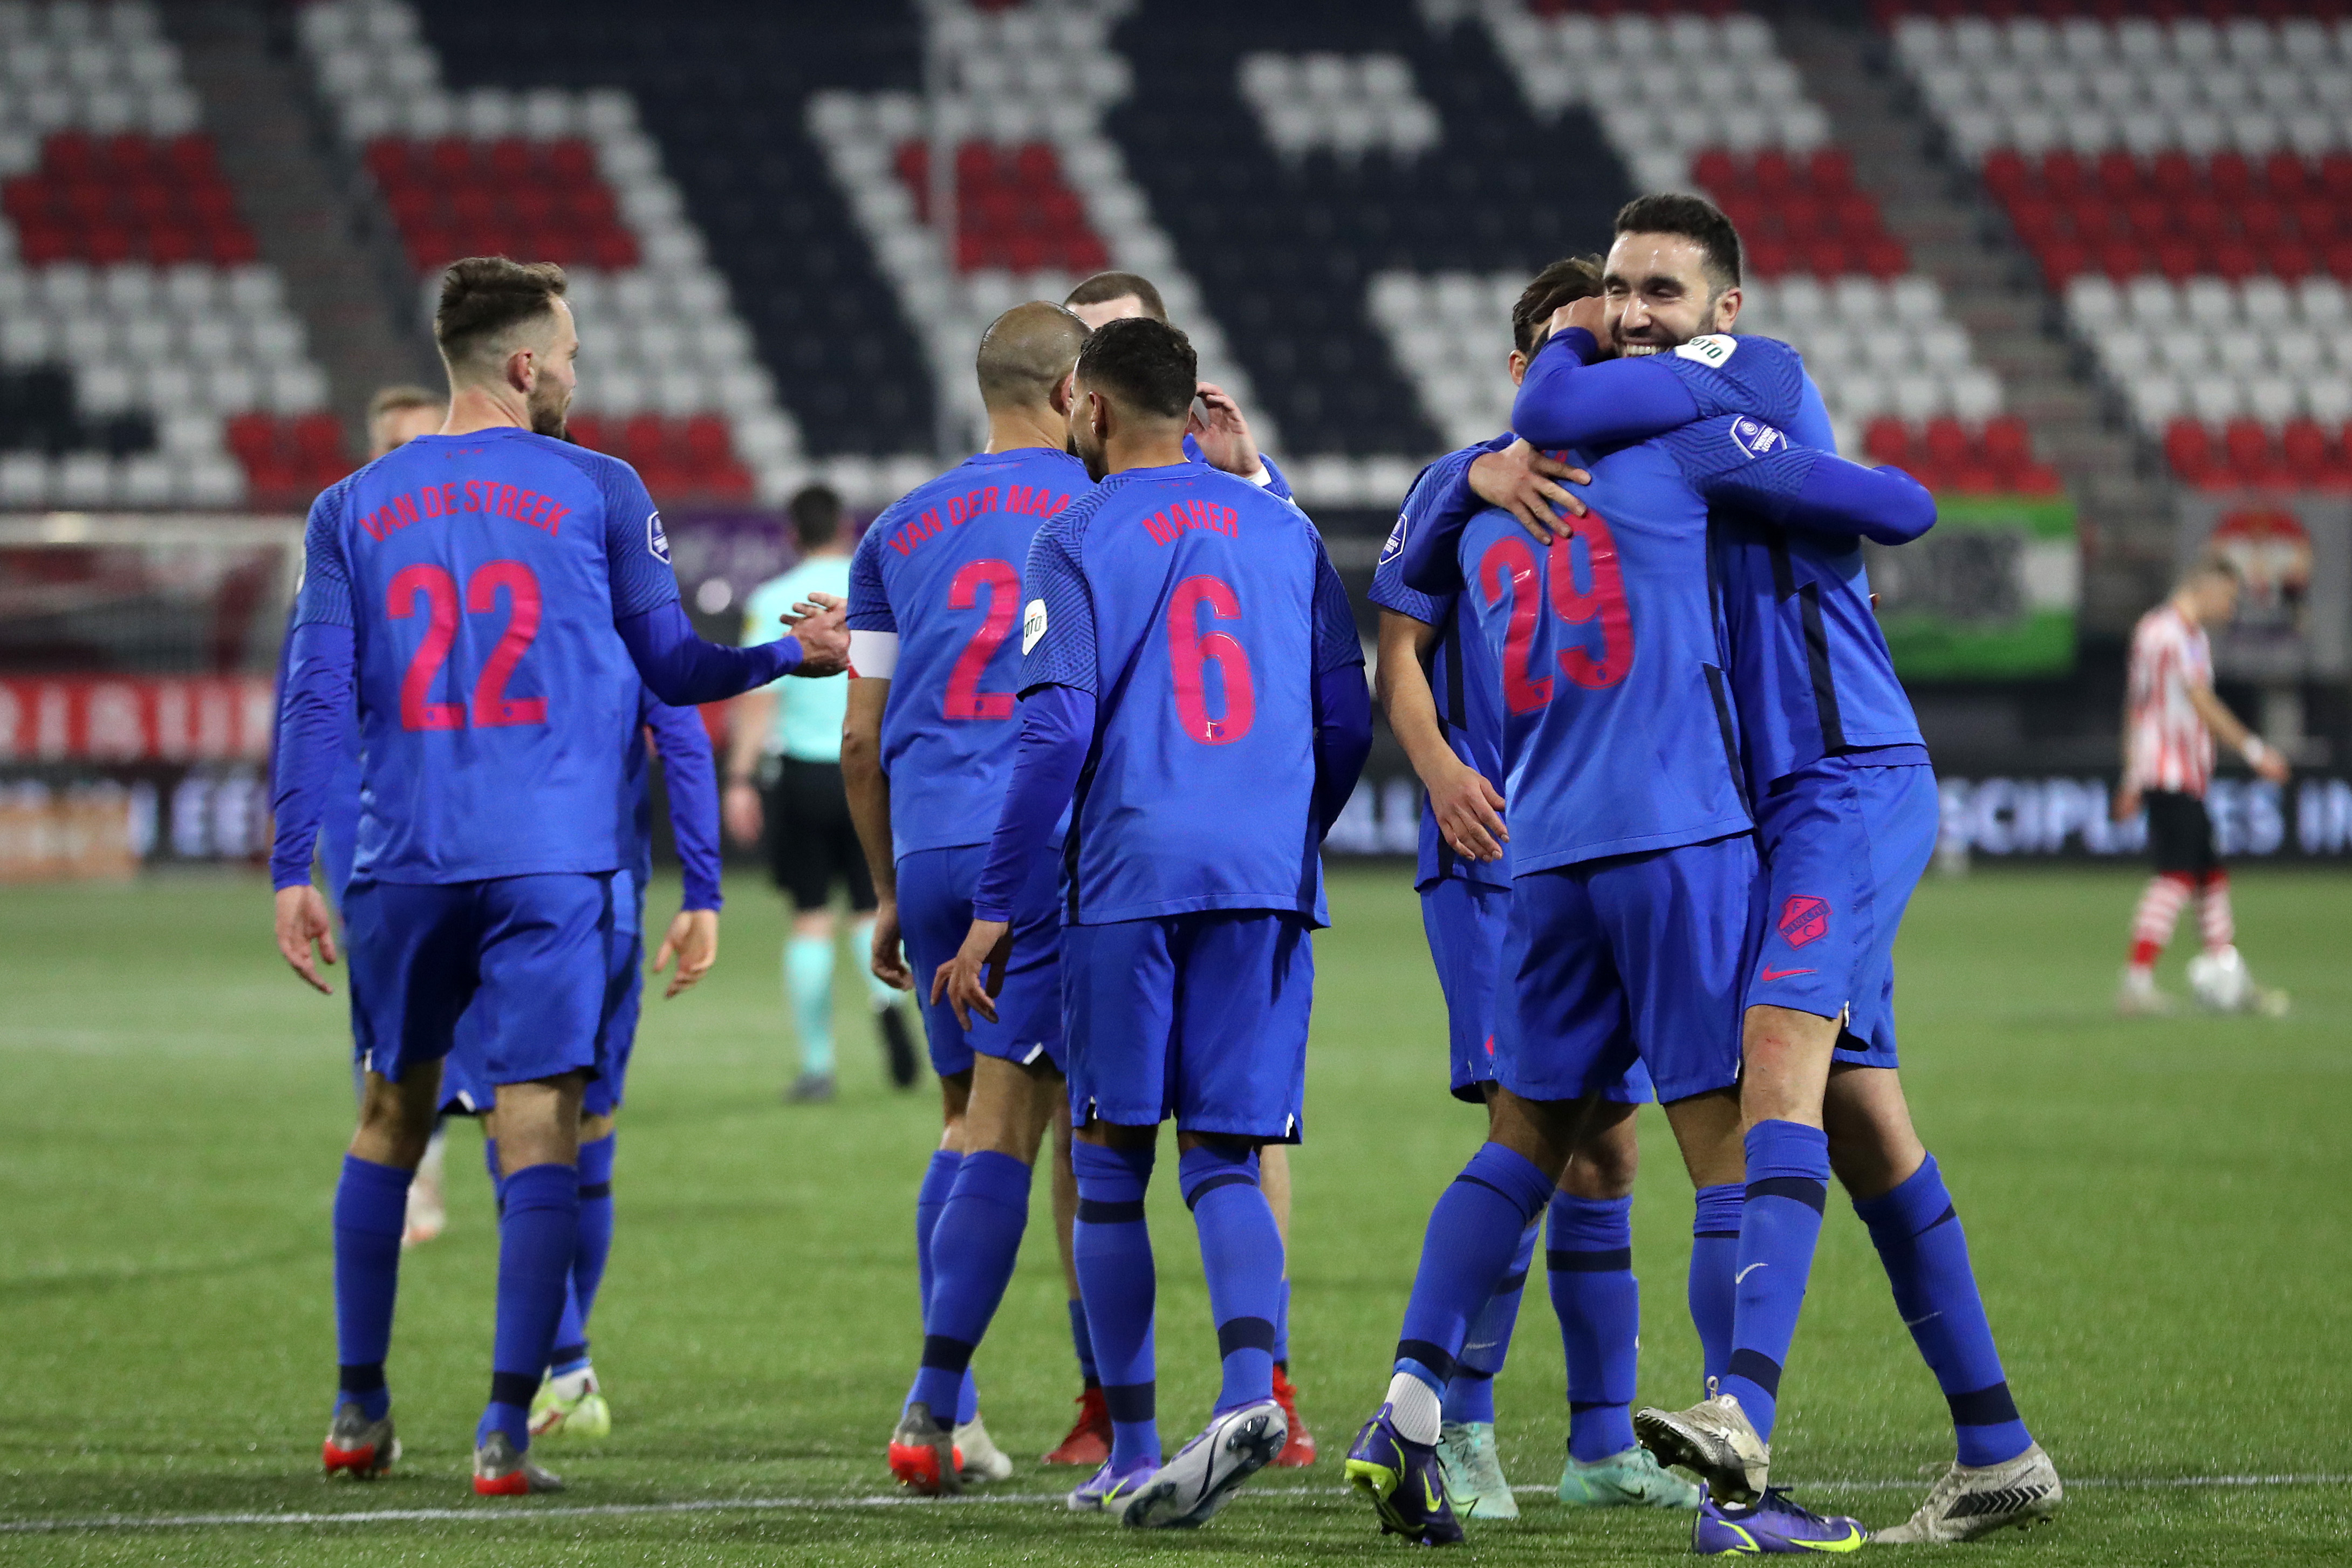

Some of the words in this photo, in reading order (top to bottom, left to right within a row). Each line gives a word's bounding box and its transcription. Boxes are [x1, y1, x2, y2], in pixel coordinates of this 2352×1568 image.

[1691, 338, 1724, 359] OTO
[359, 493, 420, 542] VAN
[421, 482, 459, 518] DE
[463, 480, 572, 537] STREEK
[887, 507, 943, 557] VAN
[947, 486, 999, 526] DER
[1142, 499, 1239, 546] MAHER
[386, 559, 549, 732] 22
[943, 558, 1021, 721] 2
[1025, 615, 1043, 638] OTO
[1479, 510, 1635, 717] 29
[1167, 574, 1256, 746] 6
